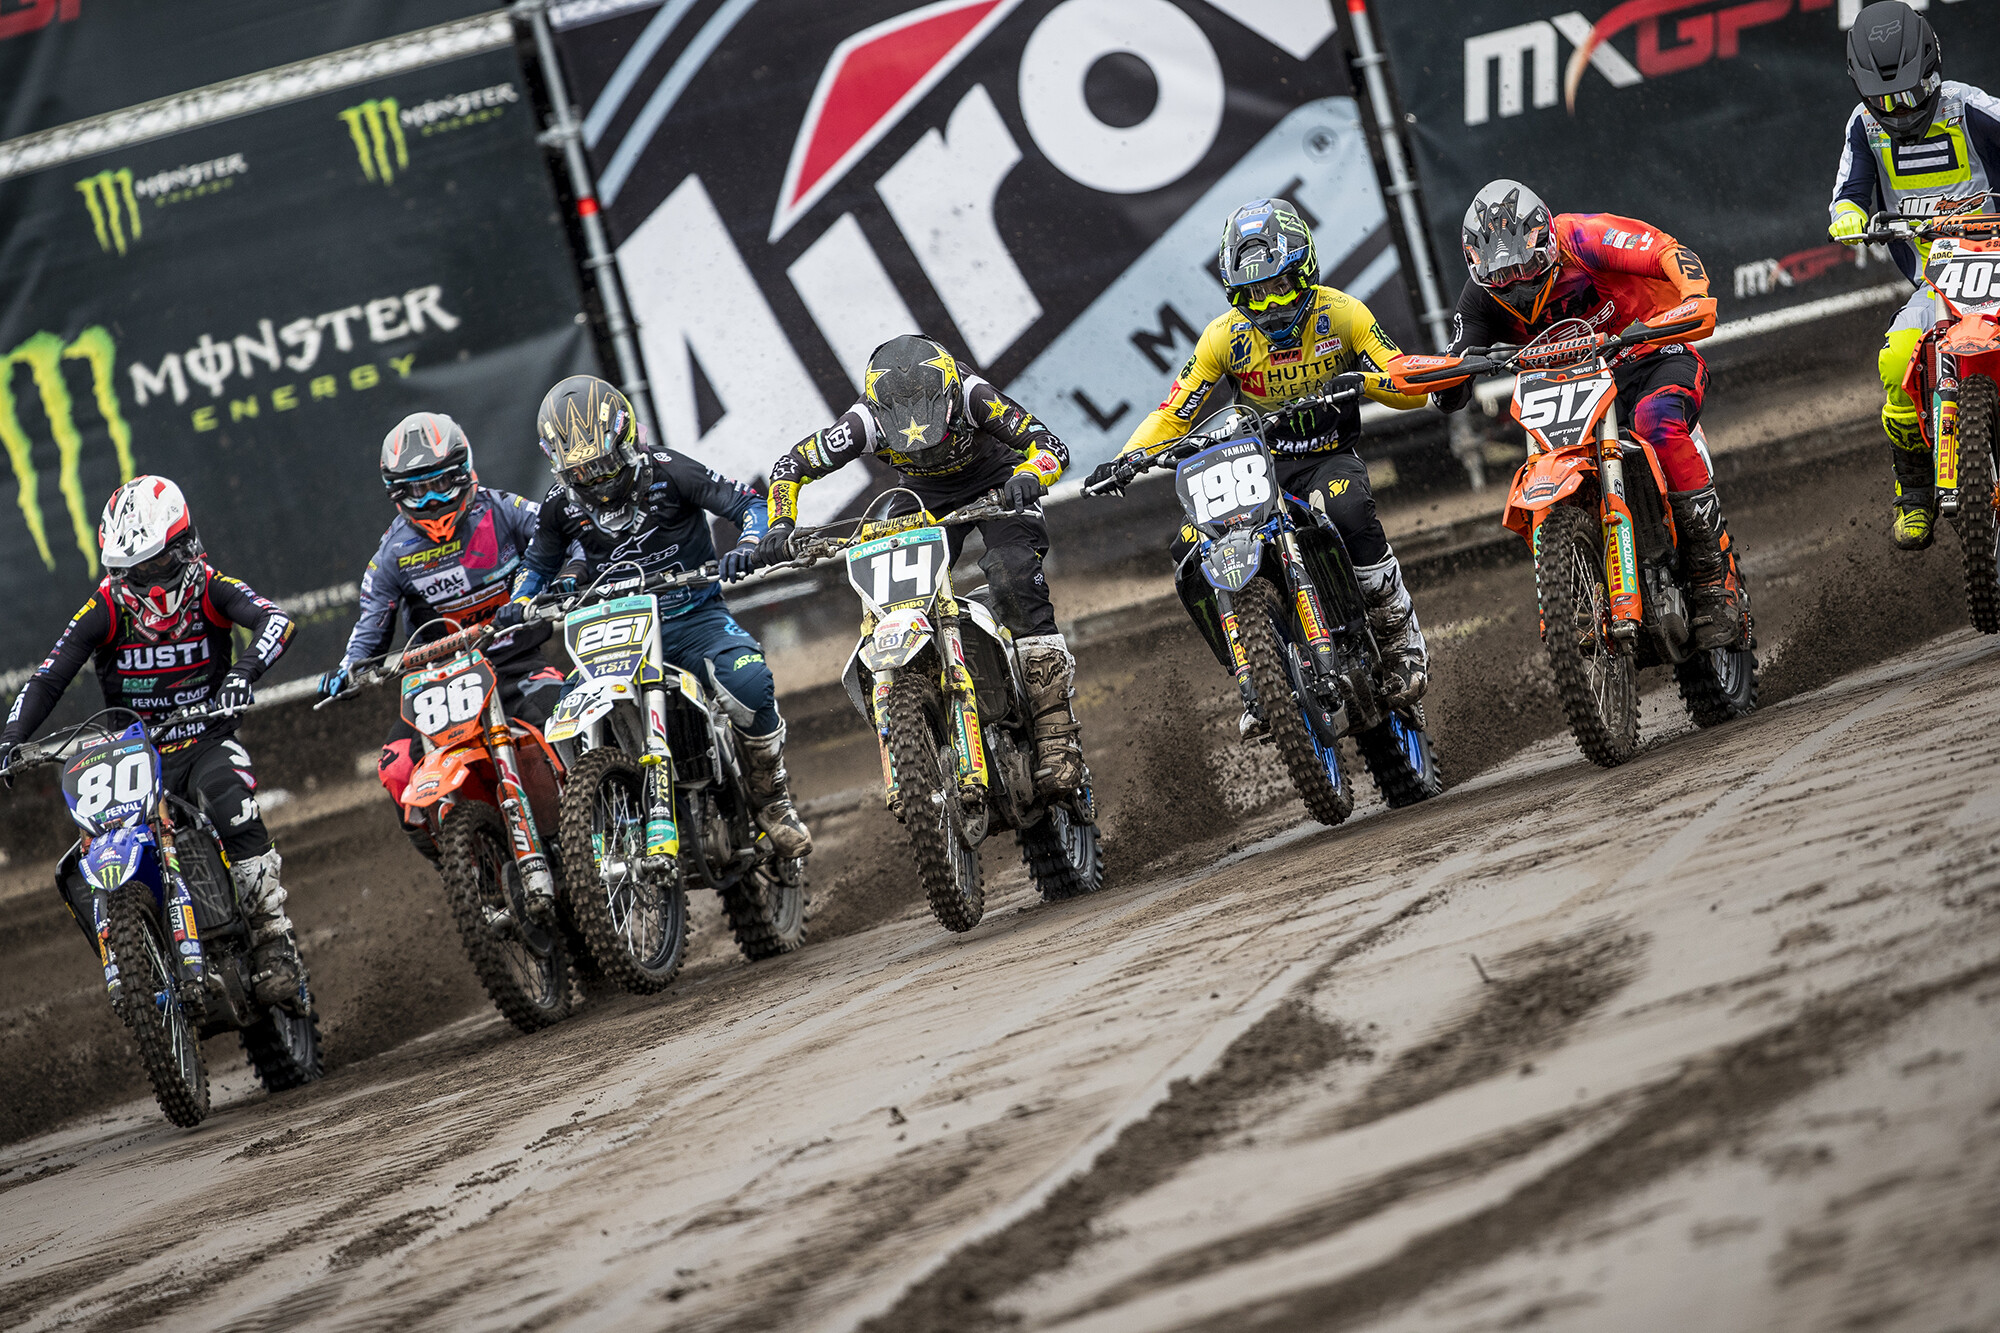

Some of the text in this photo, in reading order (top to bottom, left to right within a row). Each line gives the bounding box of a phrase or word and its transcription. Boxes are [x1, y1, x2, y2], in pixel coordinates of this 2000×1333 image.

[1932, 252, 1952, 260] ADAC
[128, 284, 462, 406] MONSTER
[1273, 351, 1299, 360] VWP
[1522, 333, 1600, 358] RENTHAL
[1267, 352, 1344, 382] HUTTEN
[190, 353, 417, 433] ENERGY
[1520, 379, 1613, 430] 517
[1221, 442, 1257, 458] YAMAHA
[1275, 429, 1339, 454] YAMAHA
[1186, 454, 1271, 525] 198
[1621, 526, 1634, 574] MOTOREX
[419, 573, 463, 599] ROYAL
[870, 544, 933, 606] 14
[1296, 591, 1320, 639] PIRELLI
[577, 616, 648, 655] 261
[116, 637, 210, 670] JUST1
[594, 660, 632, 676] ASA
[132, 697, 171, 708] FERVAL
[174, 686, 210, 705] CMP
[413, 673, 483, 734] 86
[962, 714, 984, 768] PIRELLI
[80, 751, 107, 767] ACTIVE
[76, 751, 153, 818] 80
[105, 801, 142, 819] FERVAL
